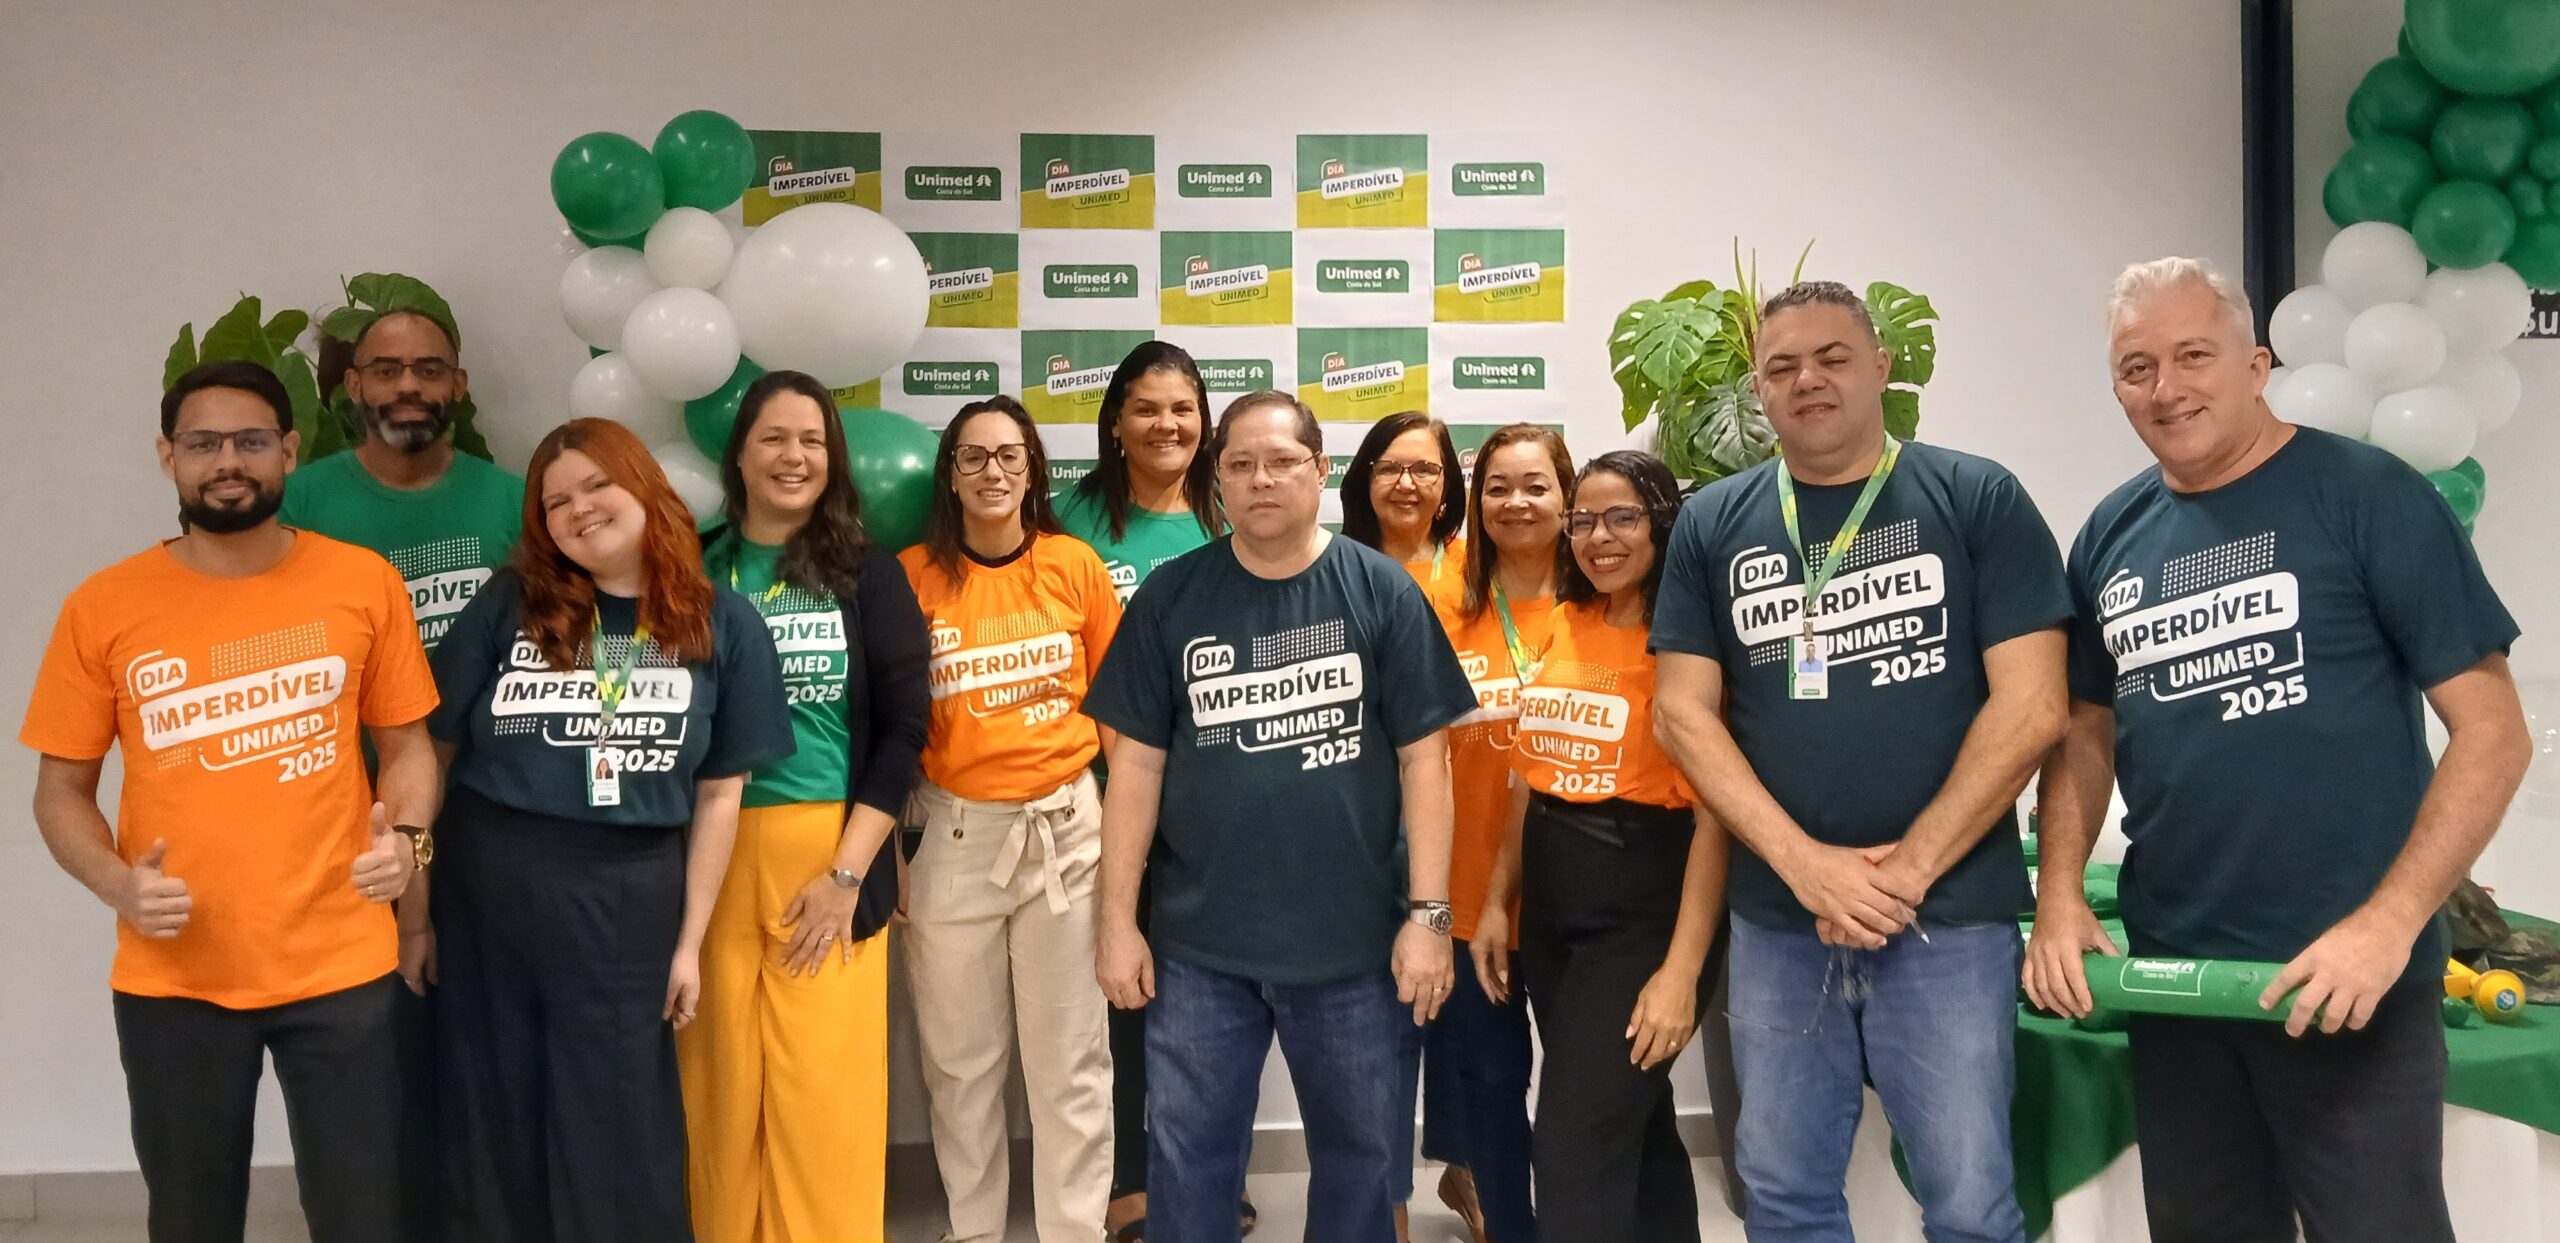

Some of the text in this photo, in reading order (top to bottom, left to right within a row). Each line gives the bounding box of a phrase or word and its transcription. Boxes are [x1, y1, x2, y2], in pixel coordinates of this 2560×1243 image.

[775, 162, 793, 172] DIA
[1052, 164, 1069, 175] DIA
[1327, 164, 1344, 175] DIA
[1461, 169, 1517, 182] Unimed
[774, 171, 850, 190] IMPERDÍVEL
[915, 174, 973, 186] Unimed
[1051, 174, 1125, 193] IMPERDÍVEL
[1187, 171, 1244, 184] Unimed
[1326, 173, 1399, 194] IMPERDÍVEL
[805, 191, 846, 203] UNIMED
[1080, 193, 1120, 205] UNIMED
[1355, 191, 1394, 204] UNIMED
[1191, 261, 1208, 272] DIA
[1325, 267, 1382, 280] Unimed
[1464, 259, 1481, 270] DIA
[929, 272, 988, 289] PERDÍVEL
[1052, 272, 1110, 284] Unimed
[1190, 270, 1263, 290] IMPERDÍVEL
[1463, 267, 1535, 287] IMPERDÍVEL
[943, 291, 983, 303] UNIMED
[1220, 288, 1259, 301] UNIMED
[1492, 286, 1531, 299] UNIMED
[1052, 360, 1070, 371] DIA
[1197, 366, 1246, 379] nimed
[1328, 357, 1345, 369] DIA
[1461, 363, 1518, 376] Unimed
[912, 369, 971, 381] Unimed
[1051, 369, 1113, 389] IMPERDÍV
[1327, 366, 1399, 386] IMPERDÍVEL
[1356, 385, 1395, 398] UNIMED
[1052, 466, 1091, 479] Unim
[1111, 570, 1134, 581] IA
[1744, 559, 1784, 584] DIA
[2106, 582, 2139, 611] DIA
[2107, 590, 2283, 659] IMPERDÍVEL
[782, 655, 831, 674] MED
[929, 643, 1069, 687] IMPERDÍVEL
[1195, 650, 1231, 671] DIA
[1462, 659, 1484, 674] IA
[1871, 646, 1946, 687] 2025
[2169, 641, 2275, 688] UNIMED
[140, 663, 183, 691] DIA
[502, 680, 679, 702] IMPERVEL
[785, 683, 843, 706] 2025
[1196, 666, 1353, 713] IMPERDÍVEL
[2220, 674, 2308, 721] 2025
[149, 671, 334, 736] IMPERDÍVEL
[1021, 696, 1070, 726] 2025
[1519, 692, 1614, 728] PERDÍVEL
[1256, 708, 1345, 741] UNIMED
[222, 714, 324, 757] UNIMED
[1301, 736, 1361, 770] 2025
[1531, 735, 1600, 762] UNIMED
[278, 741, 336, 783] 2025
[1550, 770, 1616, 794] 2025
